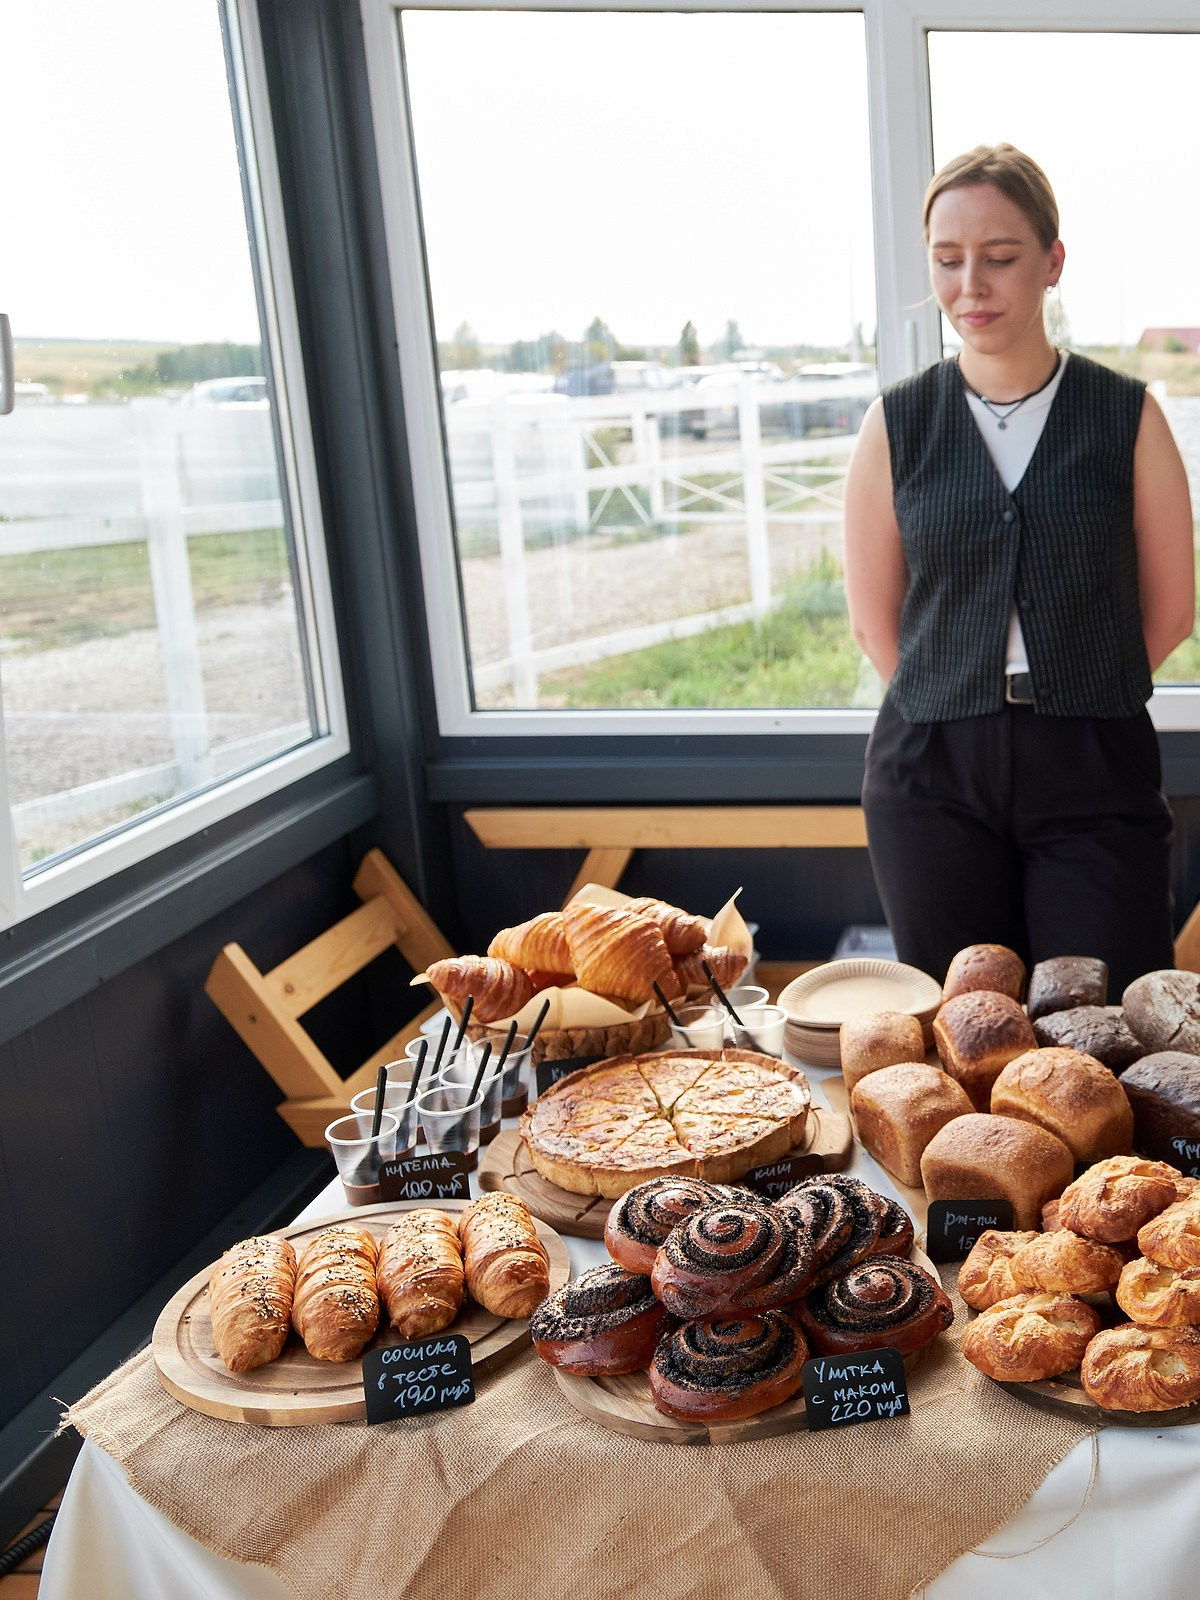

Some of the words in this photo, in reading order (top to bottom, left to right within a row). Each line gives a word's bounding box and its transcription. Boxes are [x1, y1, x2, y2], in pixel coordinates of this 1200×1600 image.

[385, 1156, 456, 1178] НУТЕЛЛА
[400, 1179, 433, 1199] 100
[377, 1372, 387, 1390] в
[392, 1363, 457, 1384] тесте
[394, 1384, 436, 1408] 190
[441, 1378, 470, 1403] руб
[834, 1381, 895, 1402] МАКОМ
[831, 1399, 872, 1422] 220
[876, 1394, 905, 1418] руб
